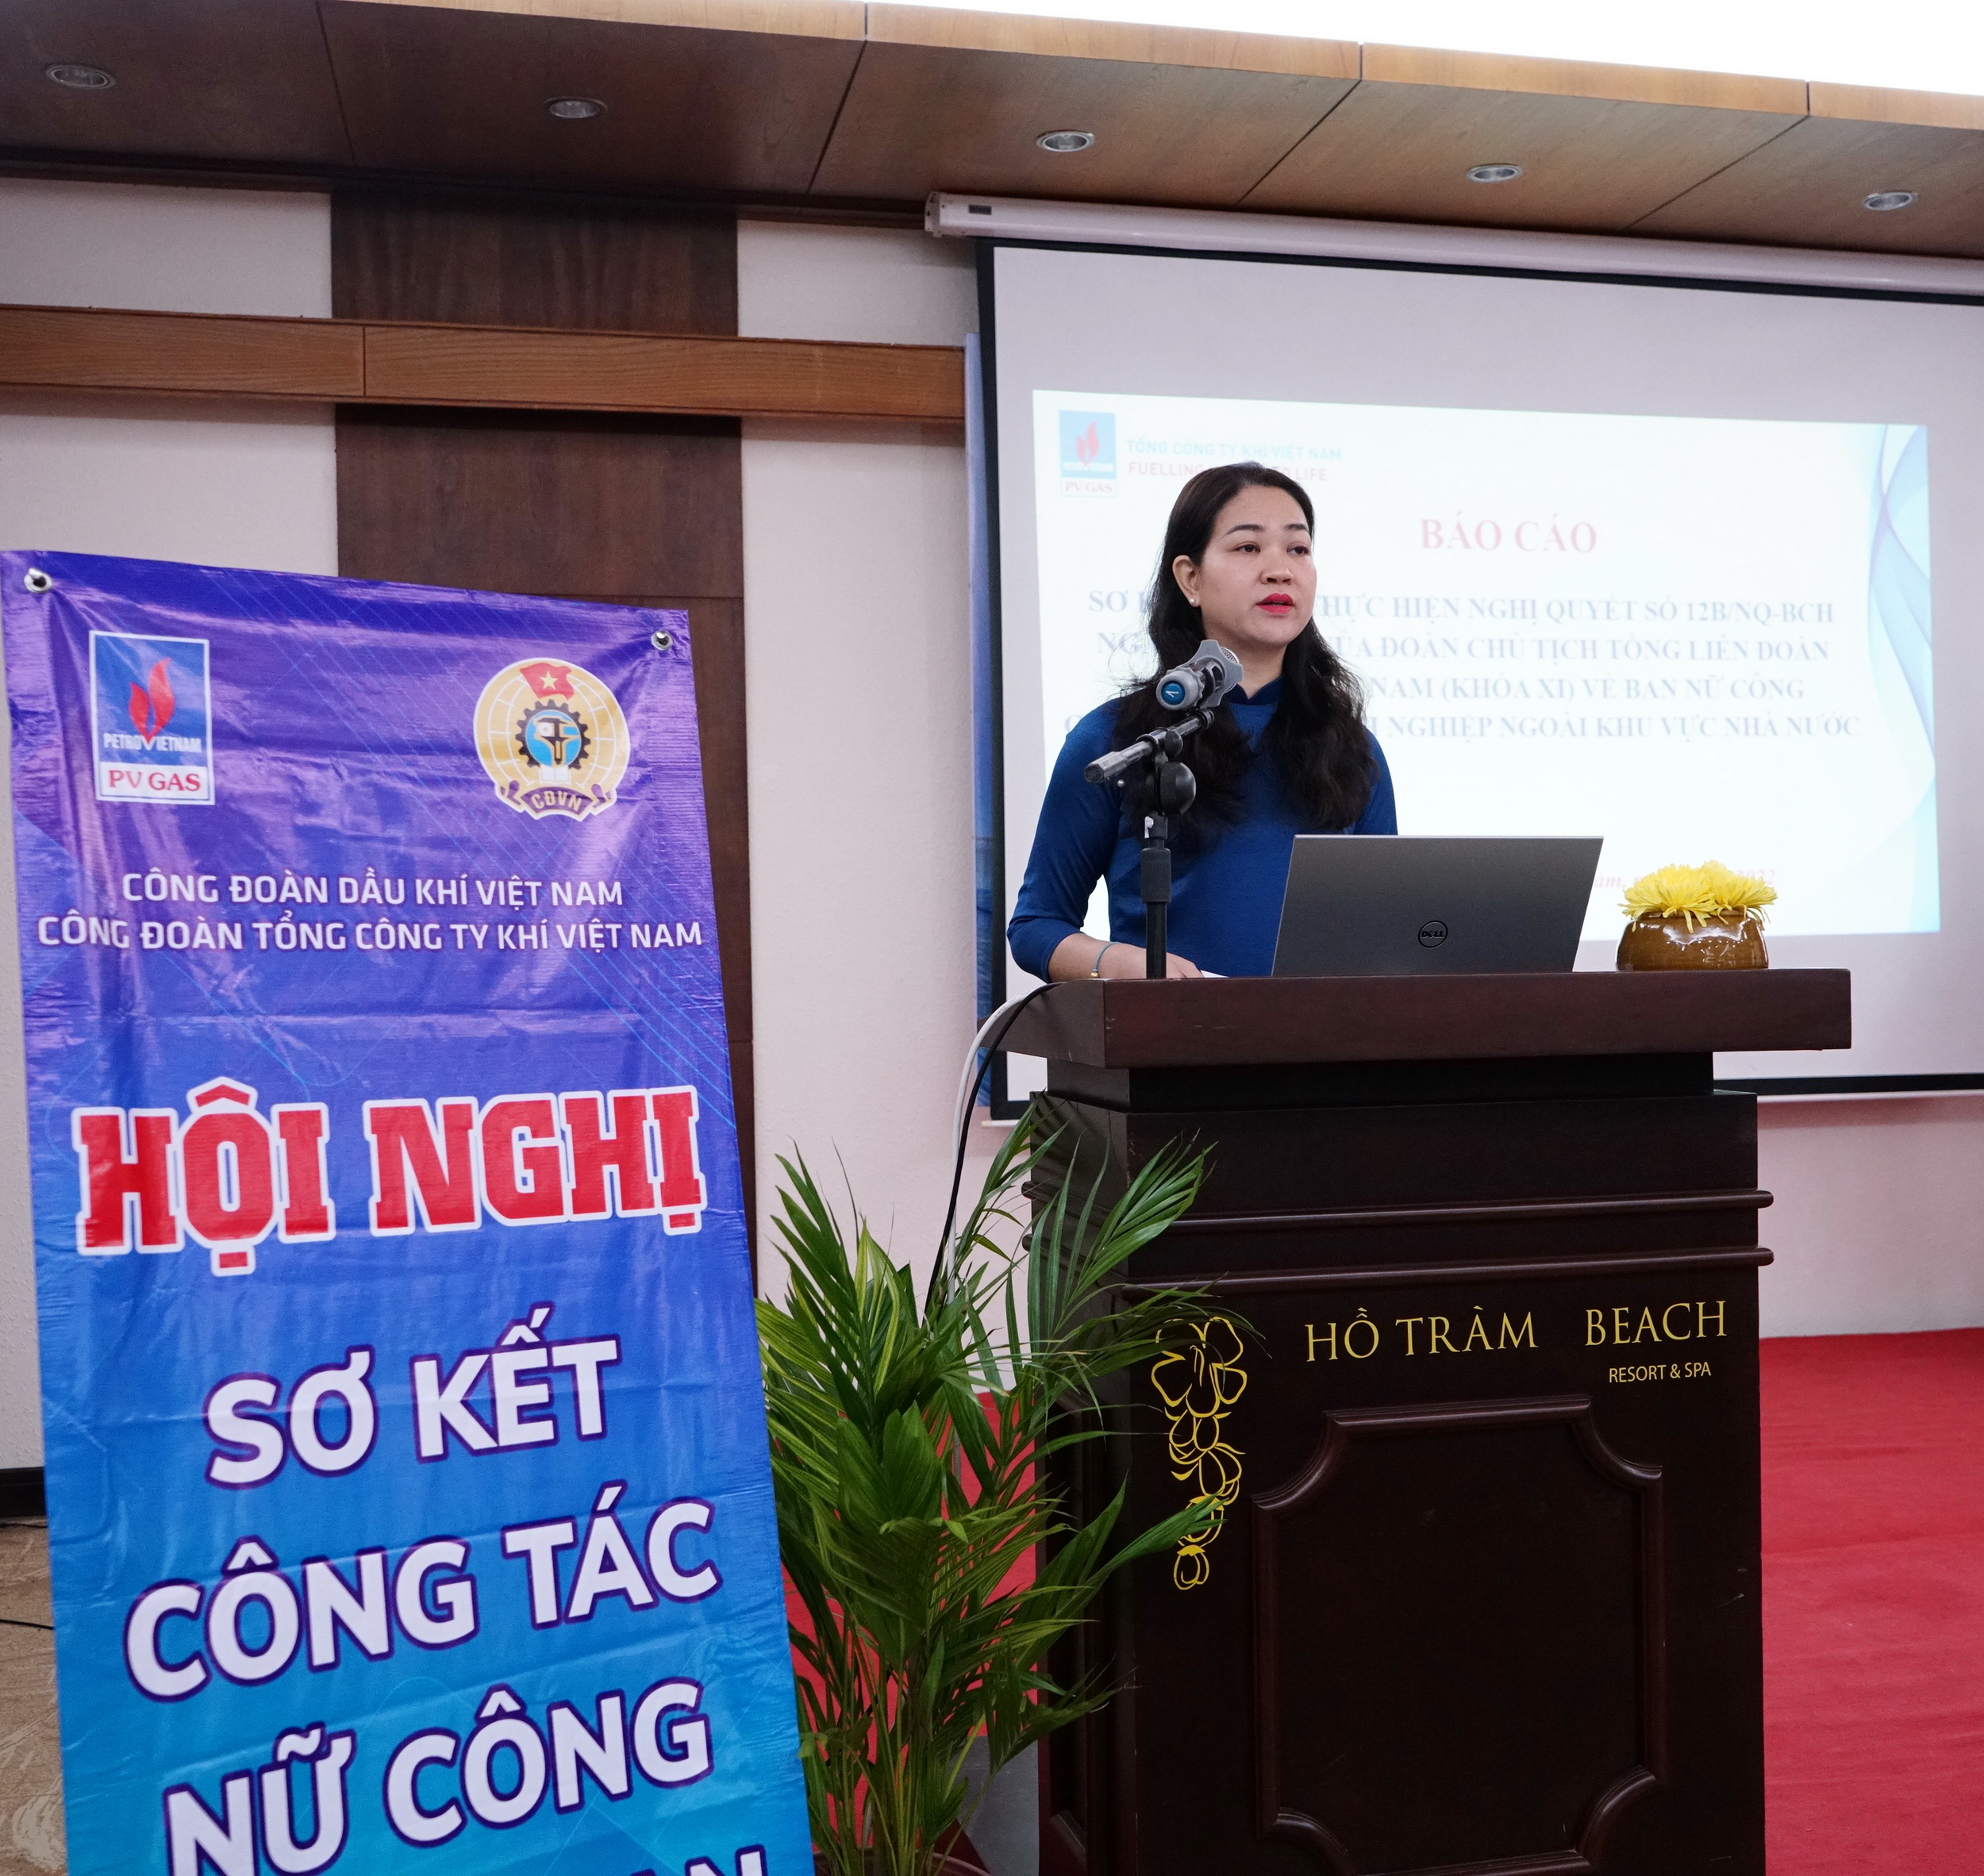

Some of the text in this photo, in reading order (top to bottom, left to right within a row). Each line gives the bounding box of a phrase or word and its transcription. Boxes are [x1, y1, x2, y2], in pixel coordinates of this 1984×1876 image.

[1172, 440, 1215, 457] CÔNG
[1218, 444, 1238, 458] TY
[1270, 444, 1304, 462] VIỆT
[1308, 448, 1342, 461] NAM
[1065, 480, 1113, 493] PV GAS
[1295, 467, 1328, 482] LIFE
[1420, 510, 1598, 553] BÁO CÁO
[1087, 588, 1130, 613] SƠ
[1393, 594, 1460, 625] HIỆN
[1468, 597, 1539, 626] NGHỊ
[1545, 593, 1638, 624] QUYẾT
[1686, 600, 1836, 628] 12B/NQ-BCH
[1327, 629, 1375, 658] ỦA
[1381, 632, 1459, 659] ĐOÀN
[1532, 637, 1599, 667] TỊCH
[1687, 632, 1750, 662] LIÊN
[1756, 635, 1830, 662] ĐOÀN
[1370, 677, 1433, 699] NAM
[1441, 671, 1531, 703] (KHÓA
[1537, 679, 1575, 702] XI)
[1624, 679, 1678, 700] BAN
[1729, 672, 1805, 700] CÔNG
[103, 732, 202, 753] PETROVIETNAM
[1389, 714, 1494, 744] NGHIỆP
[1499, 711, 1589, 739] NGOÀI
[1595, 716, 1653, 738] KHU
[1660, 713, 1716, 743] VỰC
[1723, 711, 1780, 738] NHÀ
[109, 769, 201, 792] PV GAS
[122, 866, 624, 911] CÔNG ĐOÀN DẦU KHÍ VIỆT NAM
[37, 908, 702, 953] CÔNG ĐOÀN TỔNG CÔNG TY KHÍ VIỆT NAM
[71, 1076, 708, 1278] HỘI NGHỊ
[1305, 1301, 1727, 1362] HỒ TRÀM BEACH
[1609, 1362, 1711, 1383] RESORT & SPA
[205, 1301, 621, 1489] SƠ KẾT
[123, 1481, 721, 1701] CÔNG TÁC
[163, 1678, 713, 1876] NỮ CÔNG
